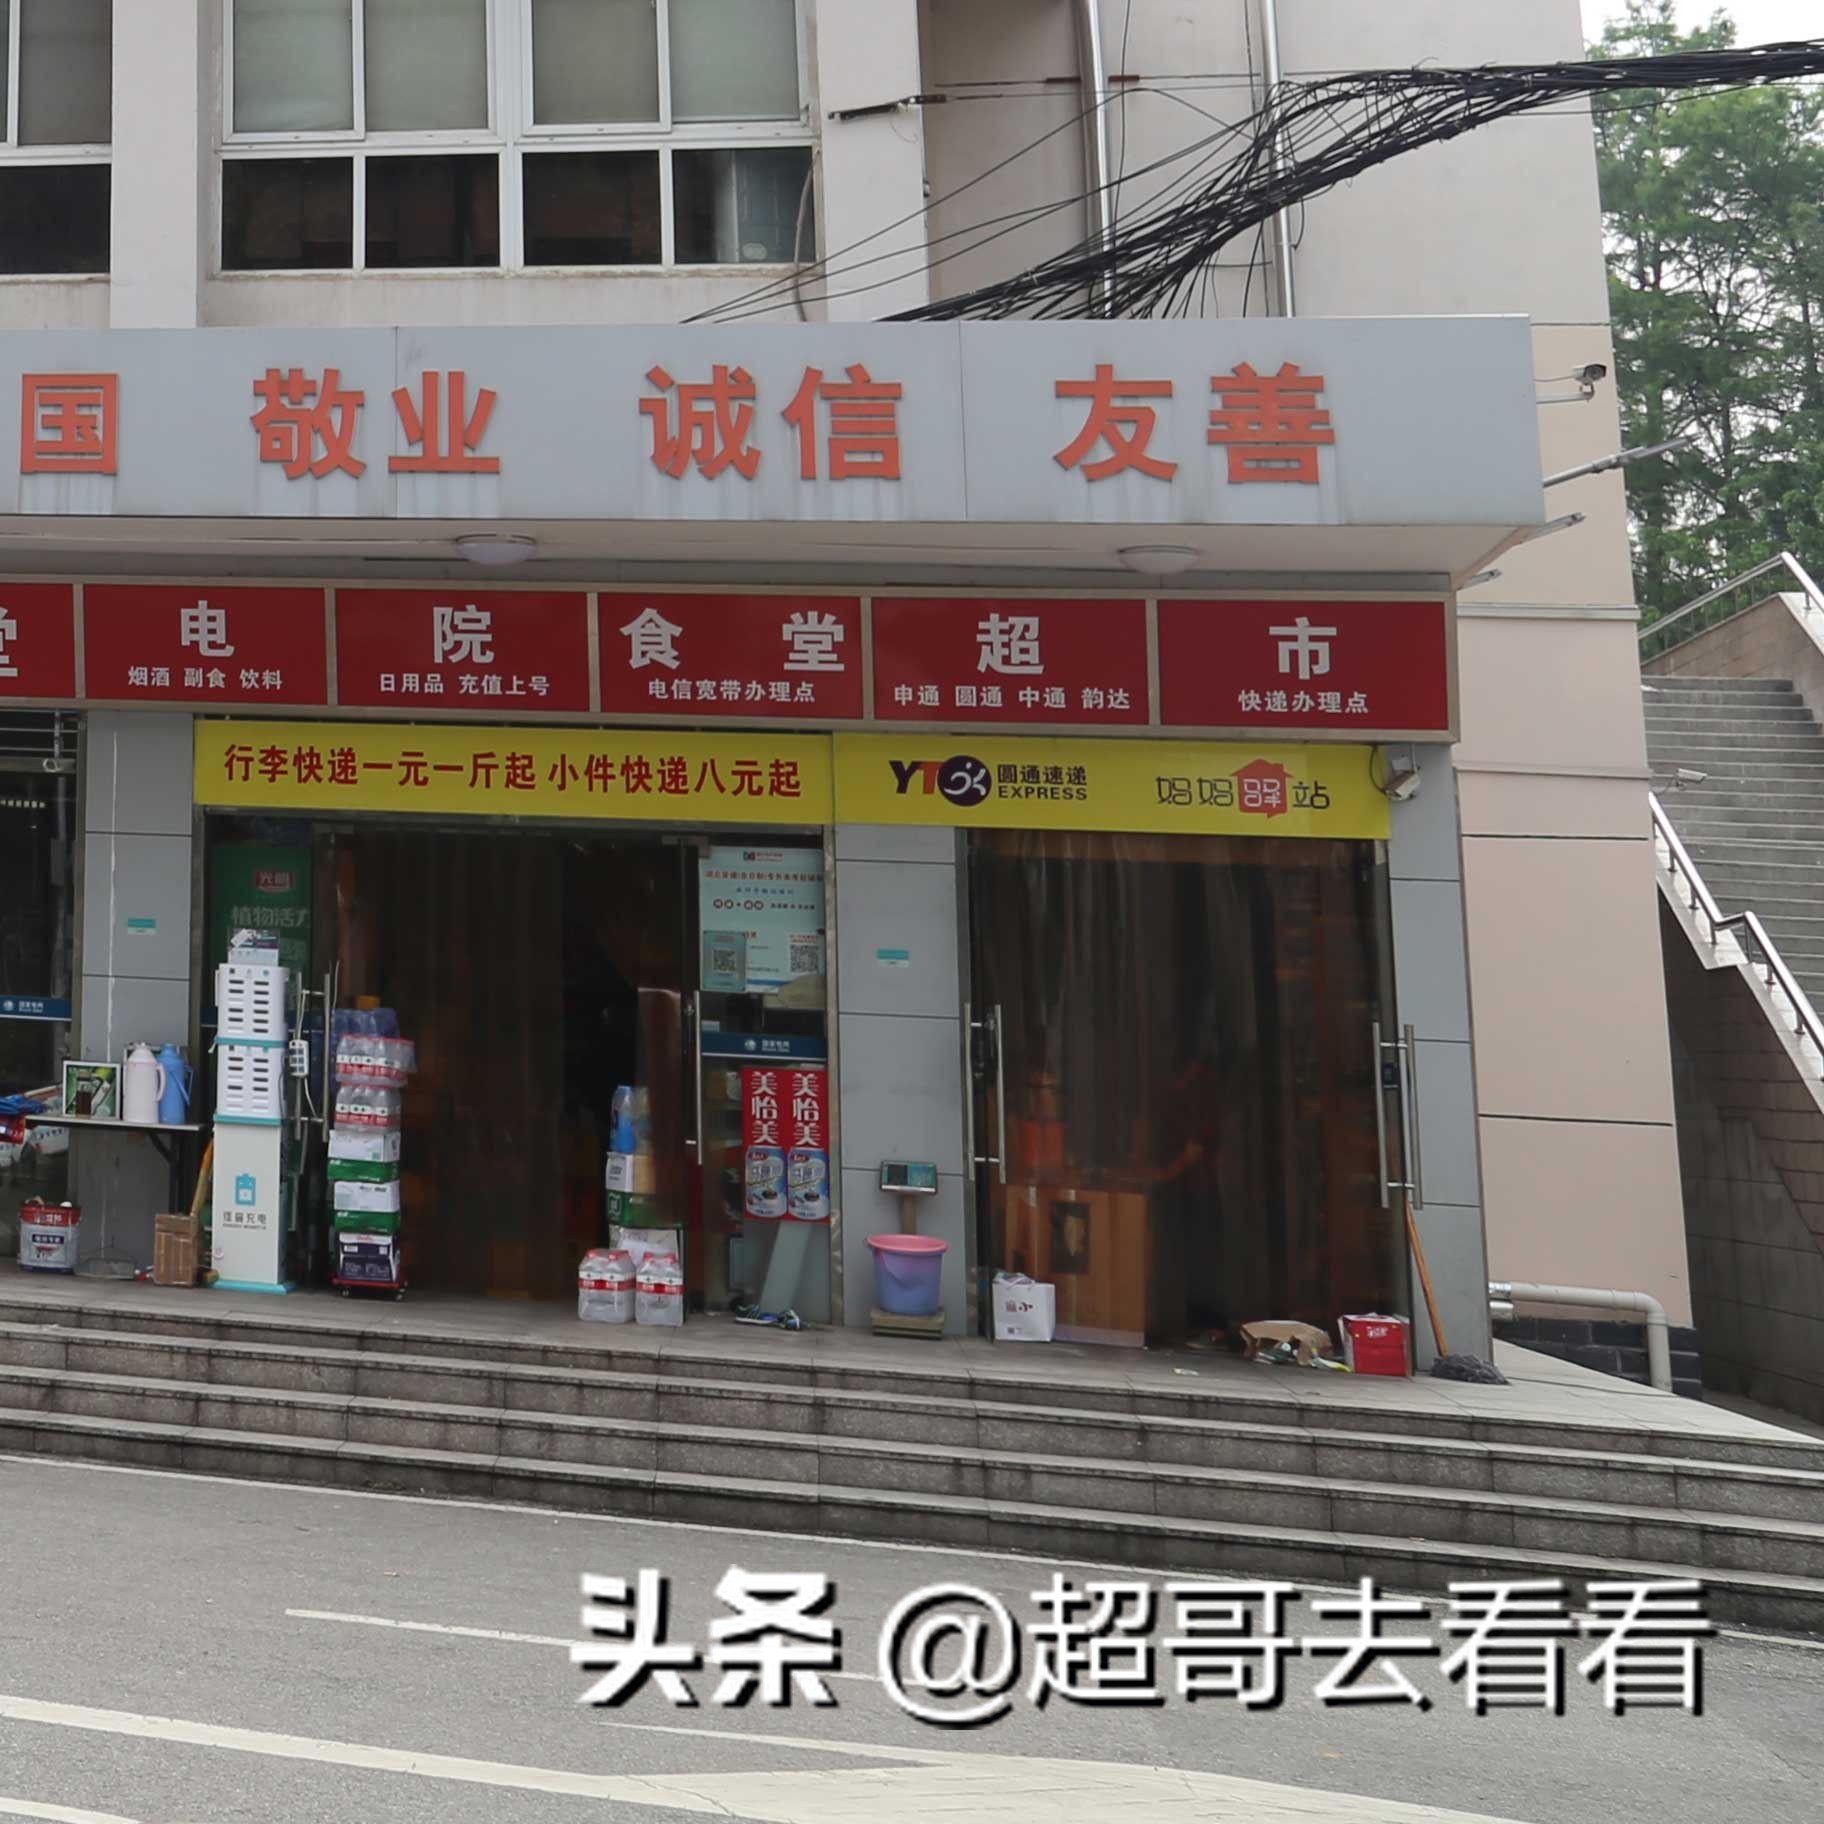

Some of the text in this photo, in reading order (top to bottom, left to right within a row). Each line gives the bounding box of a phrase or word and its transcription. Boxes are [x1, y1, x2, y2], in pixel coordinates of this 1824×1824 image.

[251, 367, 501, 478] 敬业
[639, 363, 903, 480] 诚信
[1055, 362, 1335, 485] 友善
[127, 666, 283, 690] 烟酒 副食 饮料
[379, 673, 444, 694] 日用品
[648, 678, 816, 702] 电信宽带办理点
[894, 684, 1130, 710] 申通 圆通 中通 韵达
[1238, 690, 1369, 713] 快递办理点
[224, 743, 802, 799] 行李快递一元一斤起 小件快递八元起
[997, 764, 1088, 786] 圆通速递
[997, 784, 1088, 801] EXPRESS
[752, 1071, 779, 1145] 美怡美
[792, 1073, 821, 1147] 美怡美
